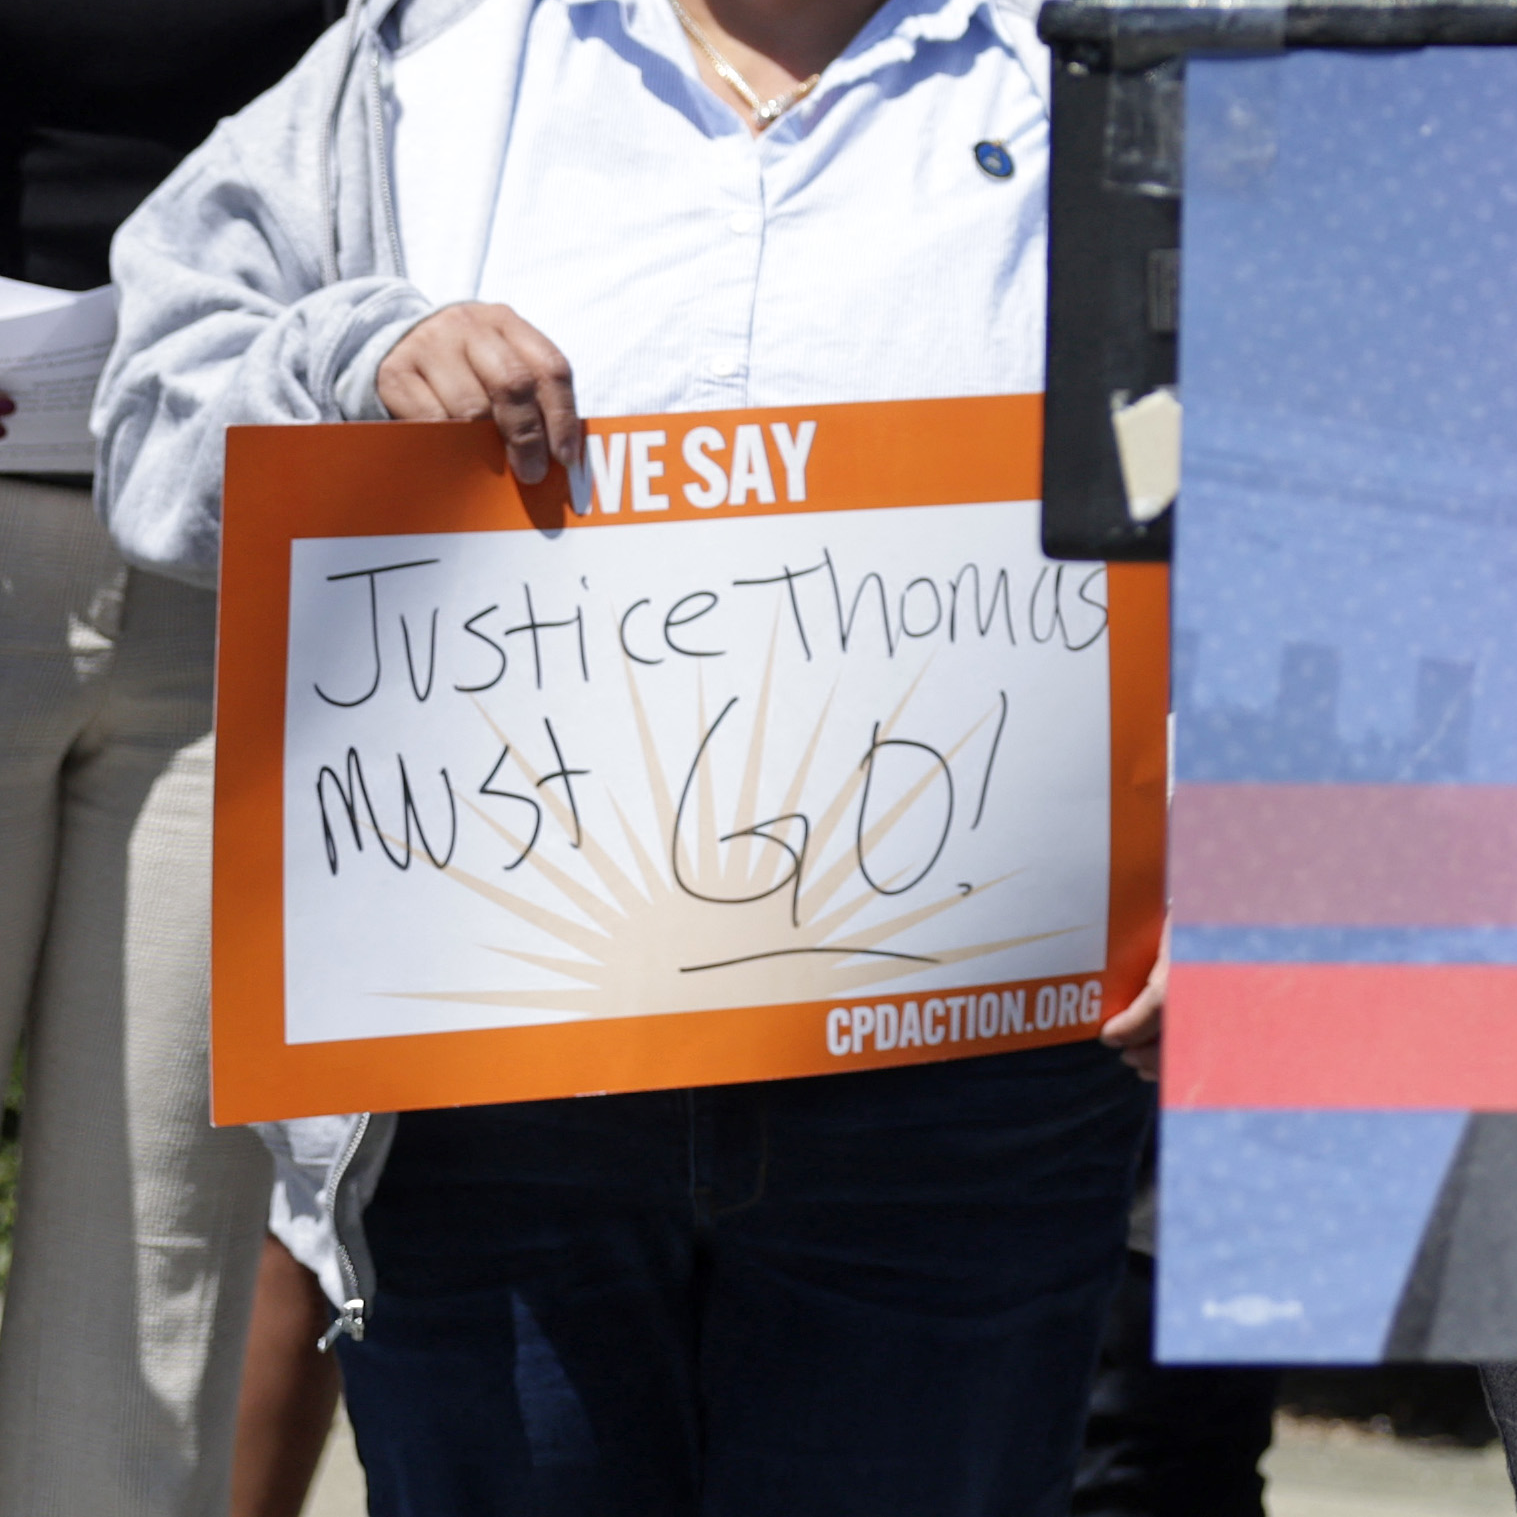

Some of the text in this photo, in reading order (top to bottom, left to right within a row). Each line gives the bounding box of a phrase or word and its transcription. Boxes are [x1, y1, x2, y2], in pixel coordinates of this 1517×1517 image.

[583, 420, 818, 516] WE SAY
[826, 988, 1104, 1057] CPDACTION.ORG
